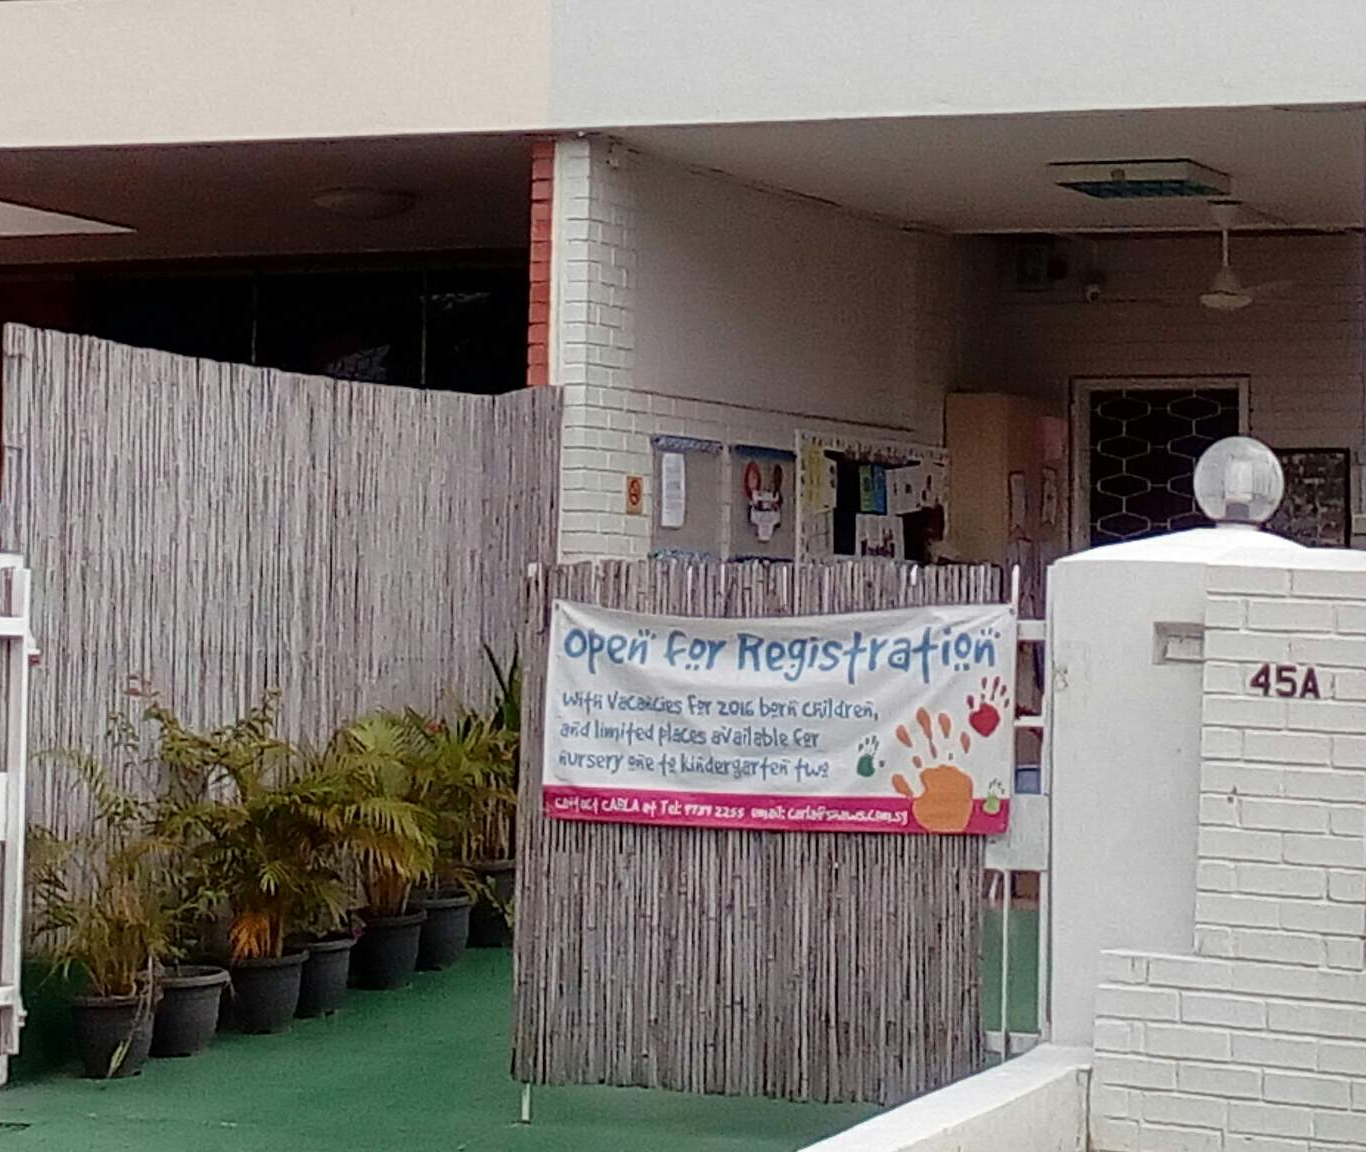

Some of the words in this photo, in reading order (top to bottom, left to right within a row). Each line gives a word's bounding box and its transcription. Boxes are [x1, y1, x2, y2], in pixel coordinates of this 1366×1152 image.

[667, 629, 726, 672] for
[736, 627, 1003, 685] Registration
[1250, 662, 1321, 699] 45A
[718, 700, 755, 716] 2016
[760, 697, 799, 719] born
[560, 721, 591, 739] and
[594, 720, 654, 746] limited
[658, 721, 708, 747] places
[711, 726, 788, 748] available
[793, 728, 820, 748] for
[558, 750, 624, 774] nursery
[627, 753, 655, 772] one
[658, 753, 677, 777] to
[681, 753, 791, 781] kindergarten
[795, 757, 830, 782] two
